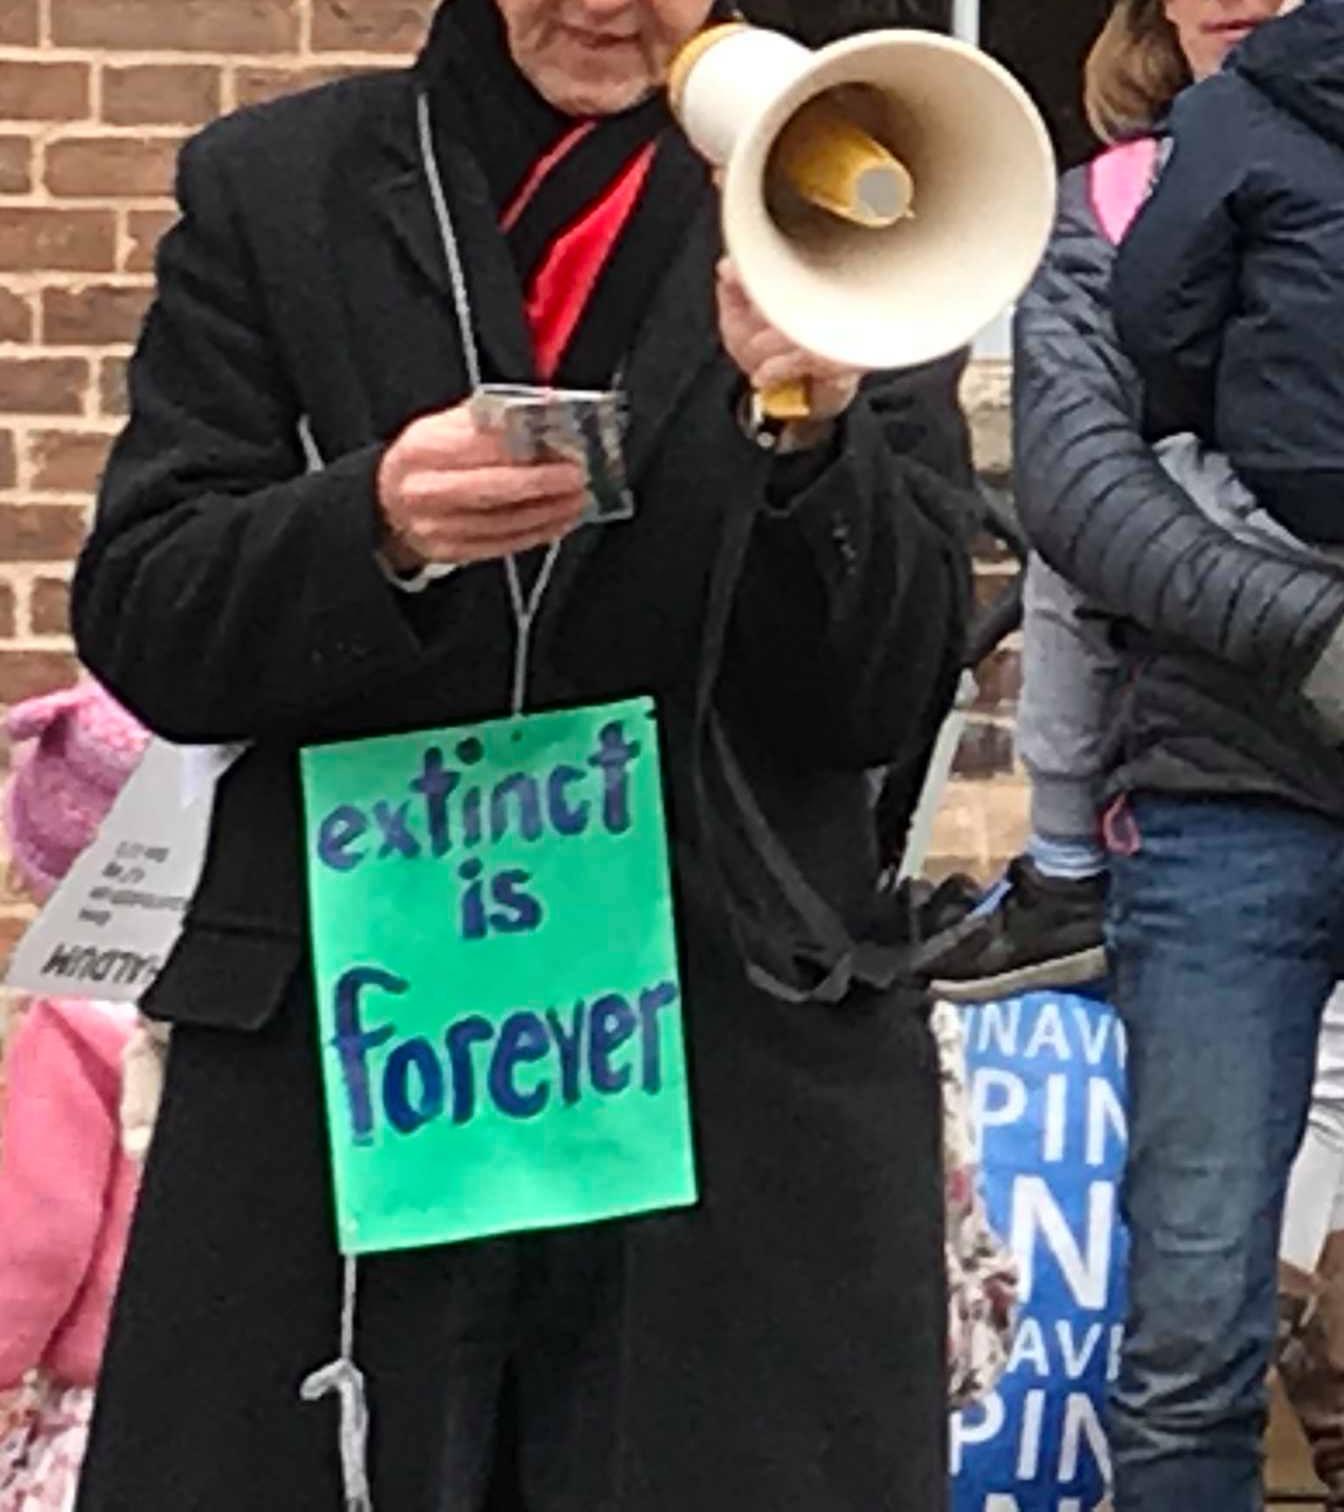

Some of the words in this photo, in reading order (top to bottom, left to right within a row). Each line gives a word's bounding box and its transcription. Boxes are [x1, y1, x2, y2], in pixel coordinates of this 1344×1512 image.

[317, 720, 641, 872] extinct
[457, 857, 544, 941] is
[330, 965, 680, 1147] forever
